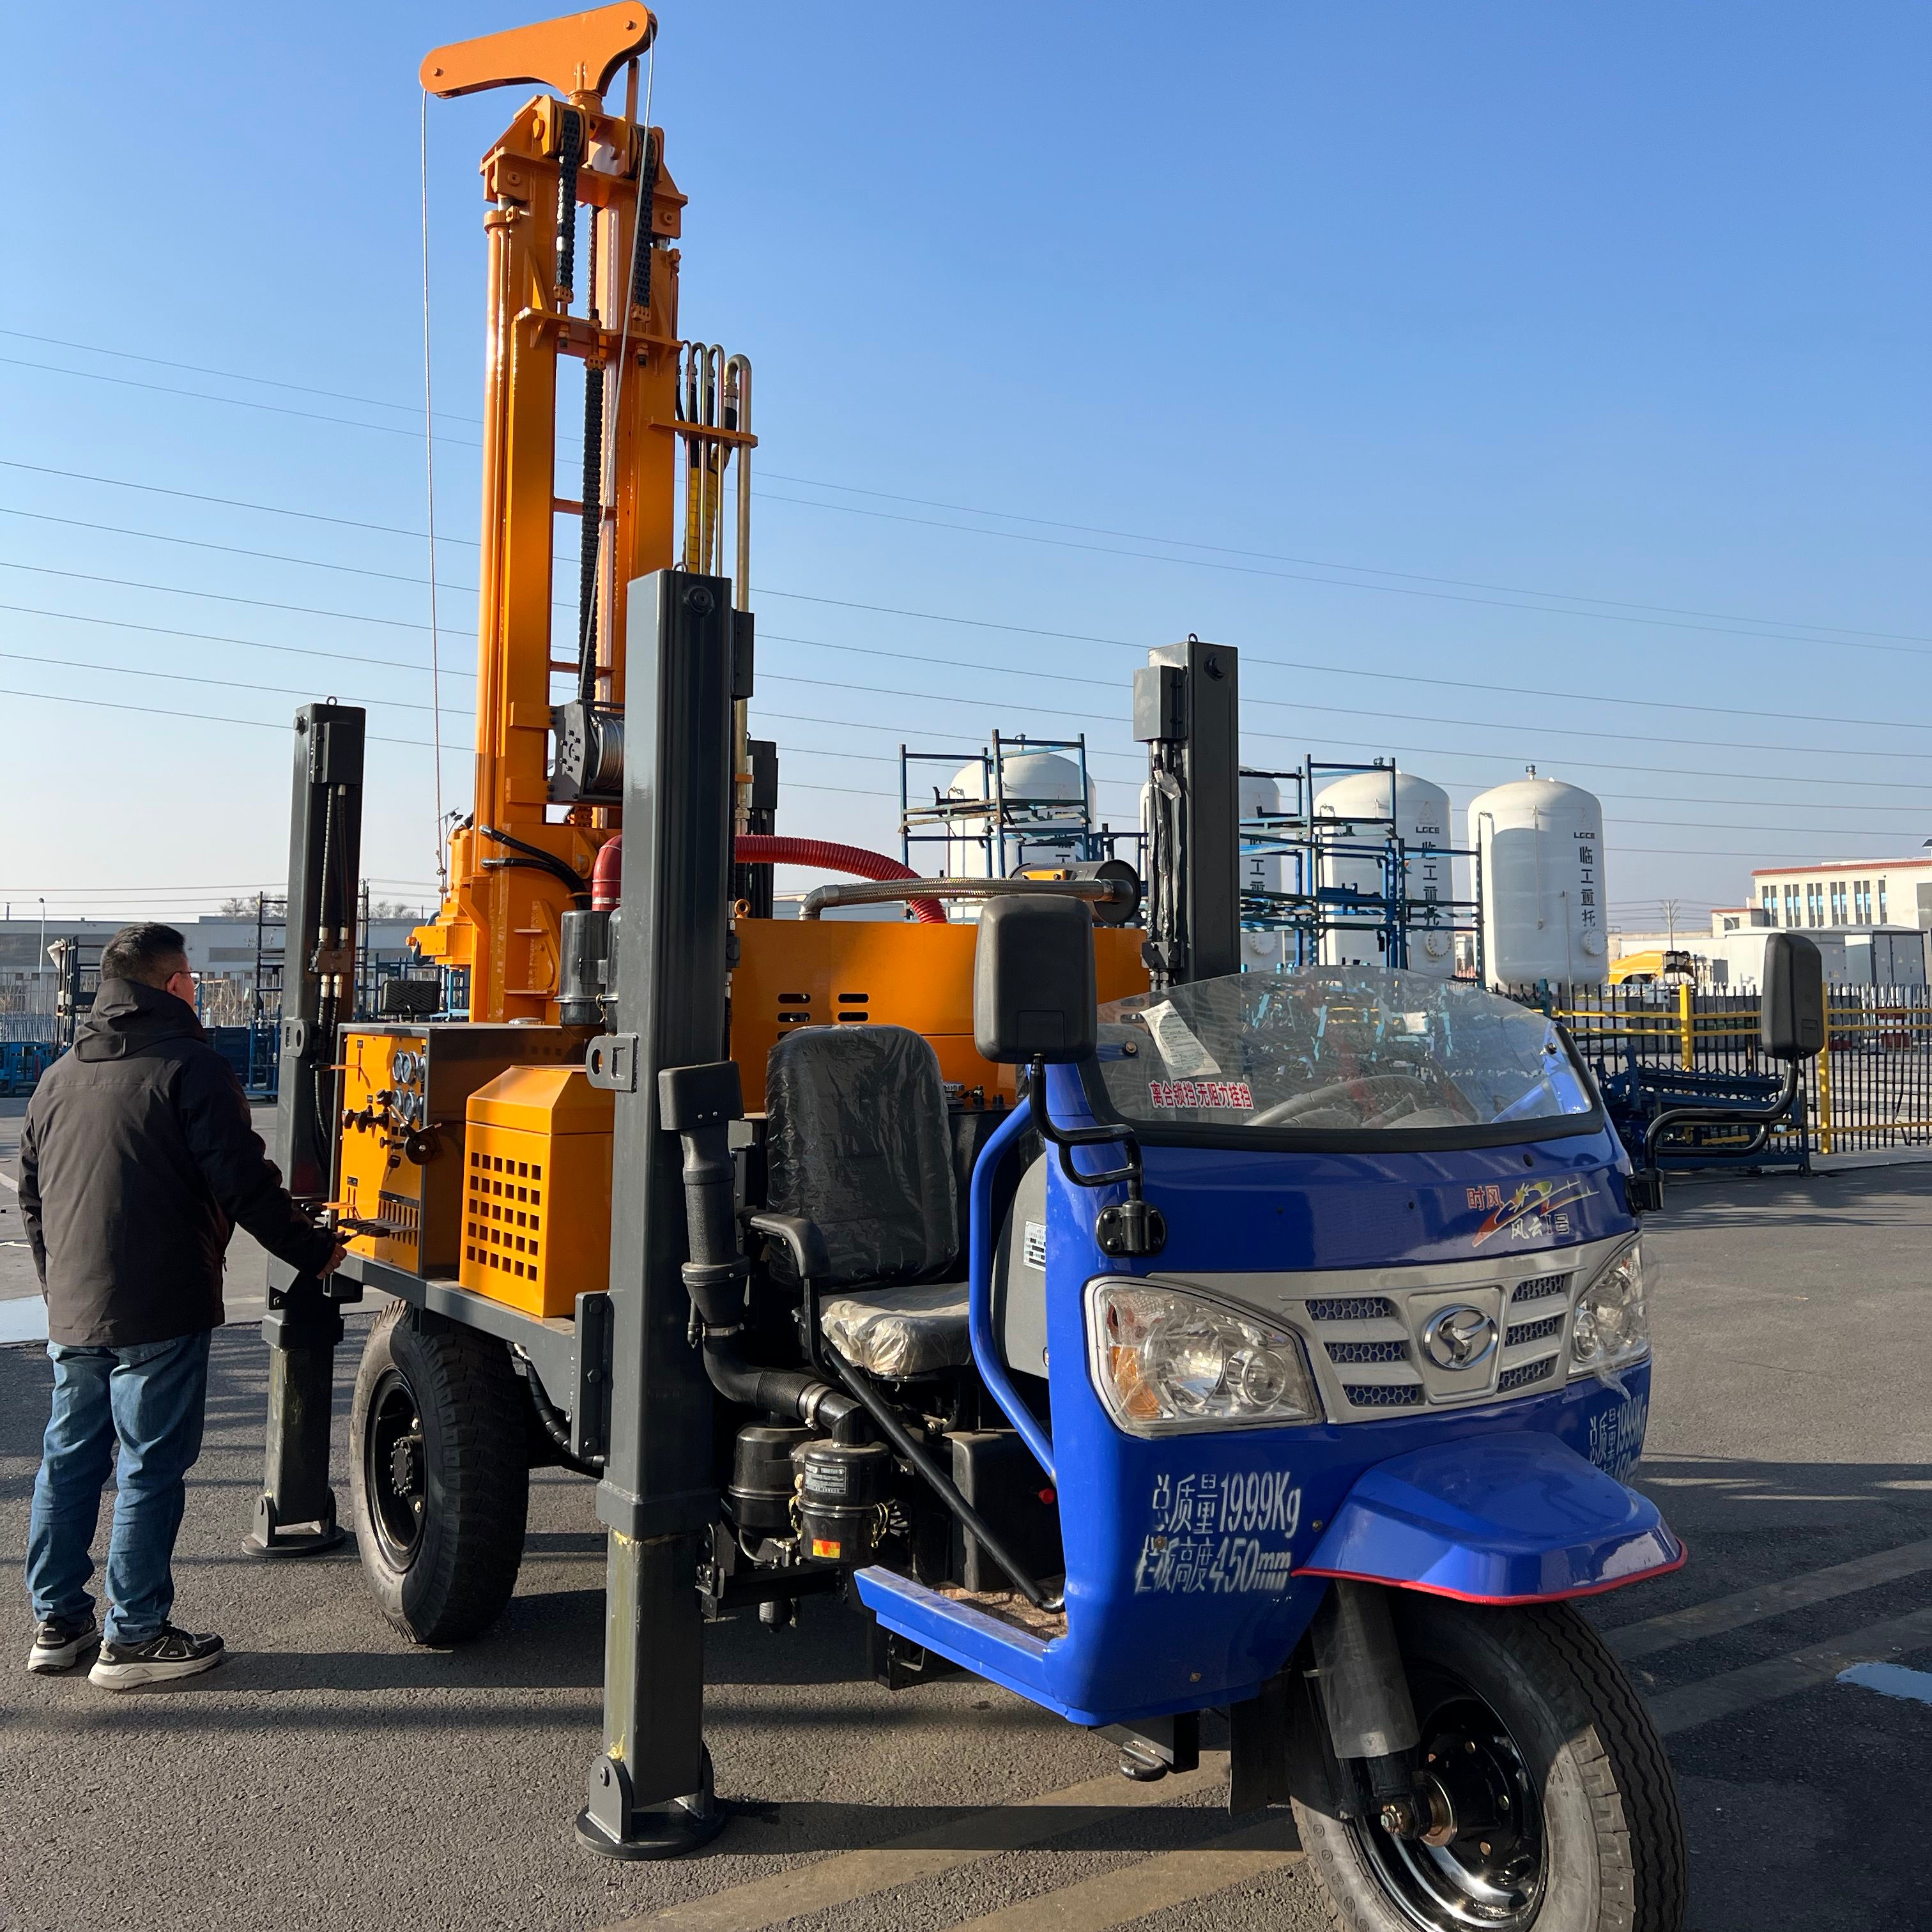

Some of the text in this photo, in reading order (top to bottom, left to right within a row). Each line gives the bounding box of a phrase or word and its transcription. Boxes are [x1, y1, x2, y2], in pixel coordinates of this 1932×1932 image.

[1579, 846, 1595, 926] 临工重托
[1466, 1185, 1505, 1211] 时风
